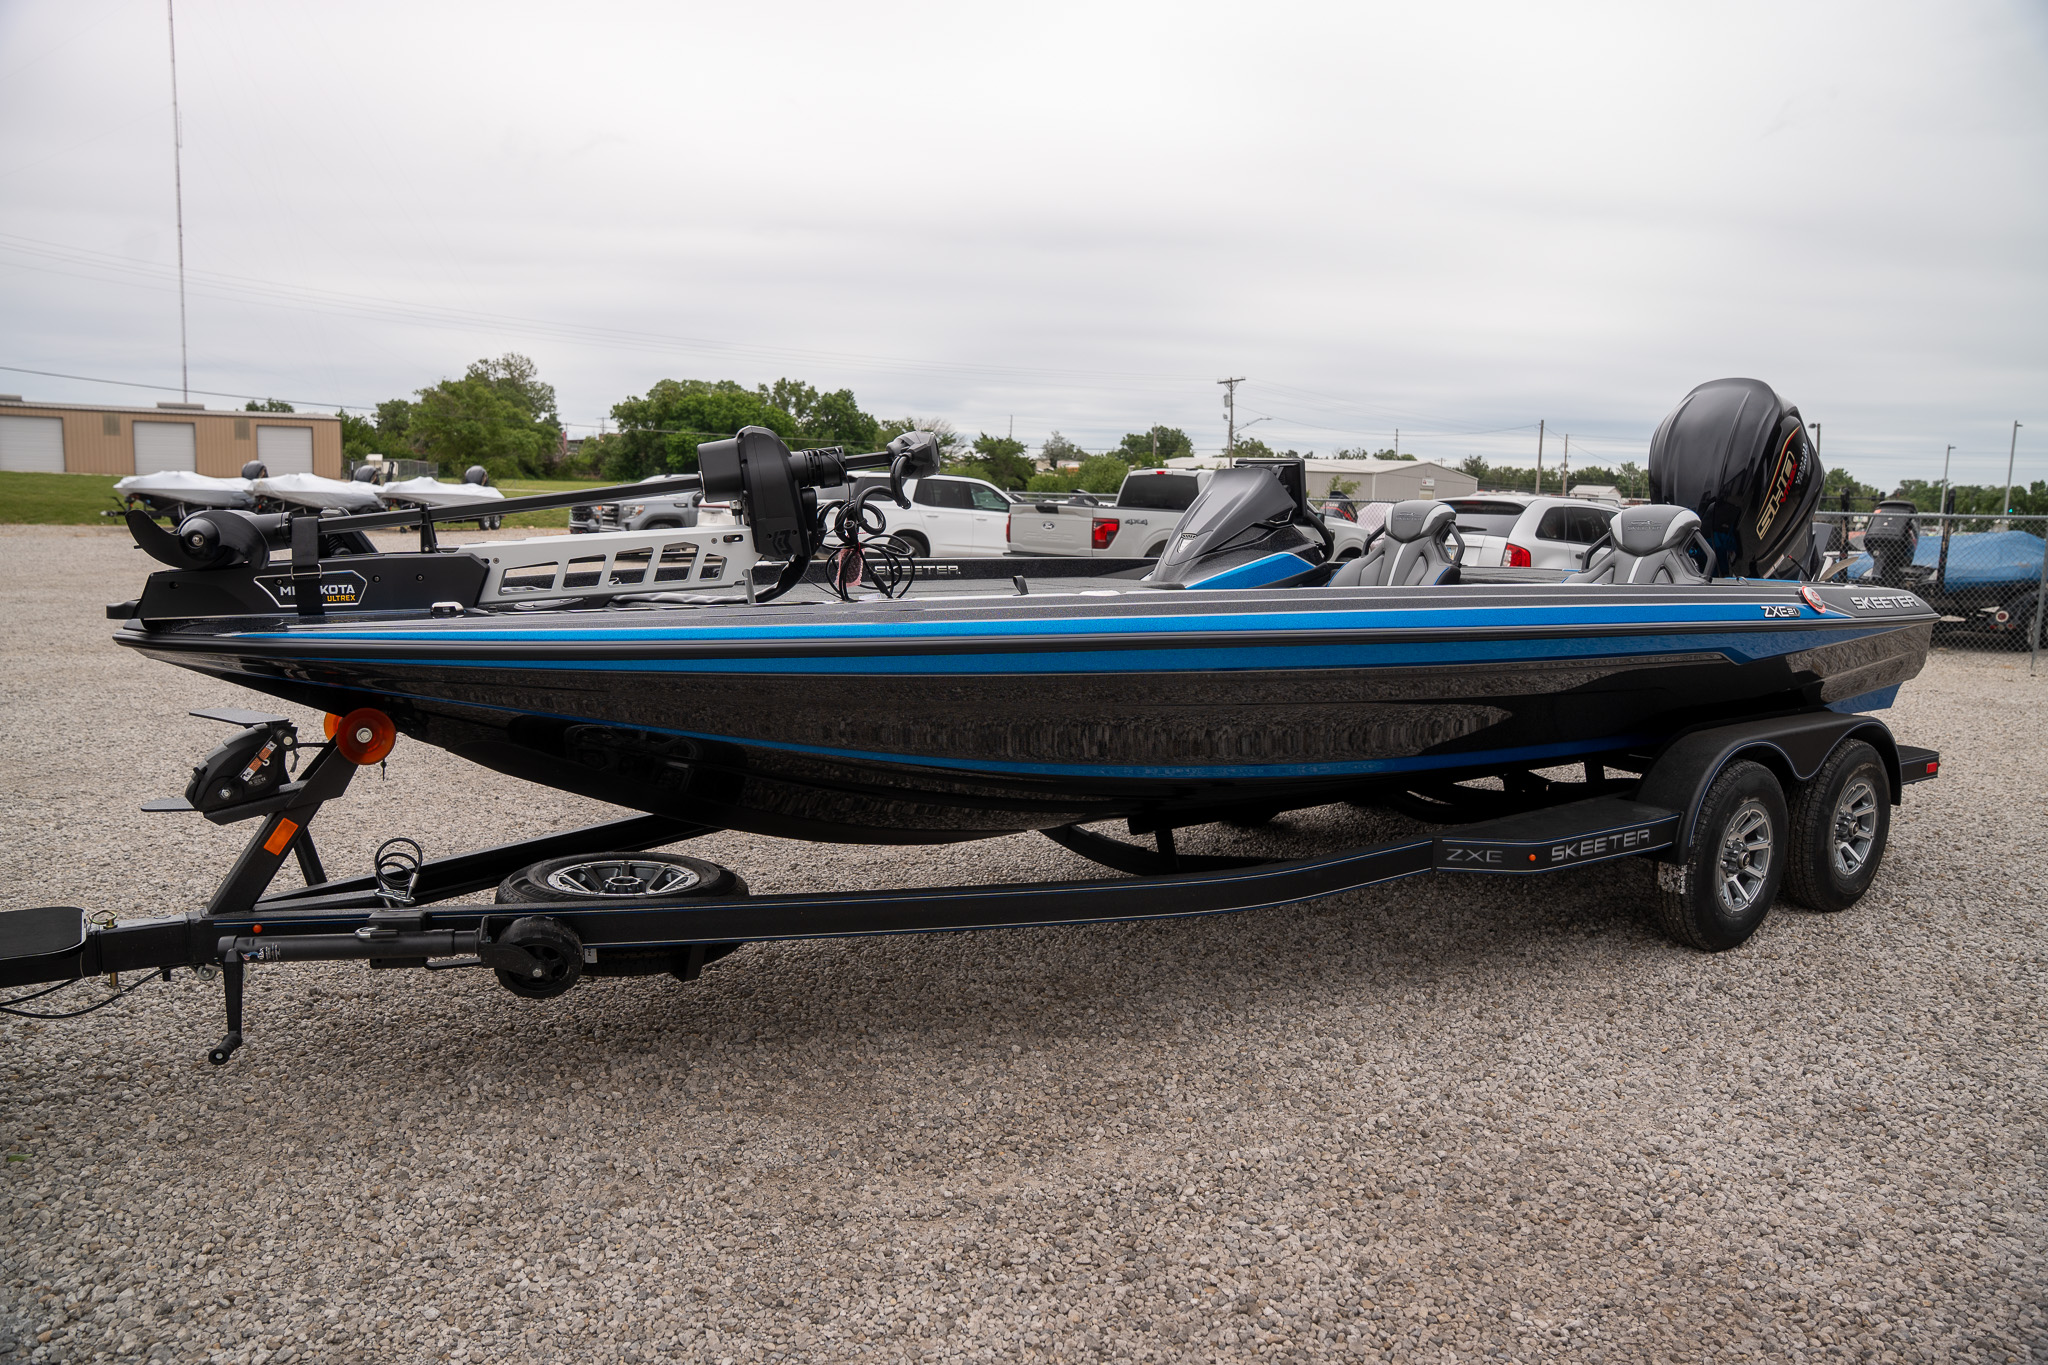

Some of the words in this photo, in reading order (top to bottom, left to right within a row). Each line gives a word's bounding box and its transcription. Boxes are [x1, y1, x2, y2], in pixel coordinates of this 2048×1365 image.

[1796, 443, 1808, 485] YAMAHA
[1756, 451, 1796, 540] SHO
[320, 584, 355, 595] KOTA
[326, 594, 356, 602] ULTREX
[1850, 596, 1919, 610] SKEETER
[1551, 829, 1651, 862] SKEETER
[1446, 849, 1503, 863] ZXE
